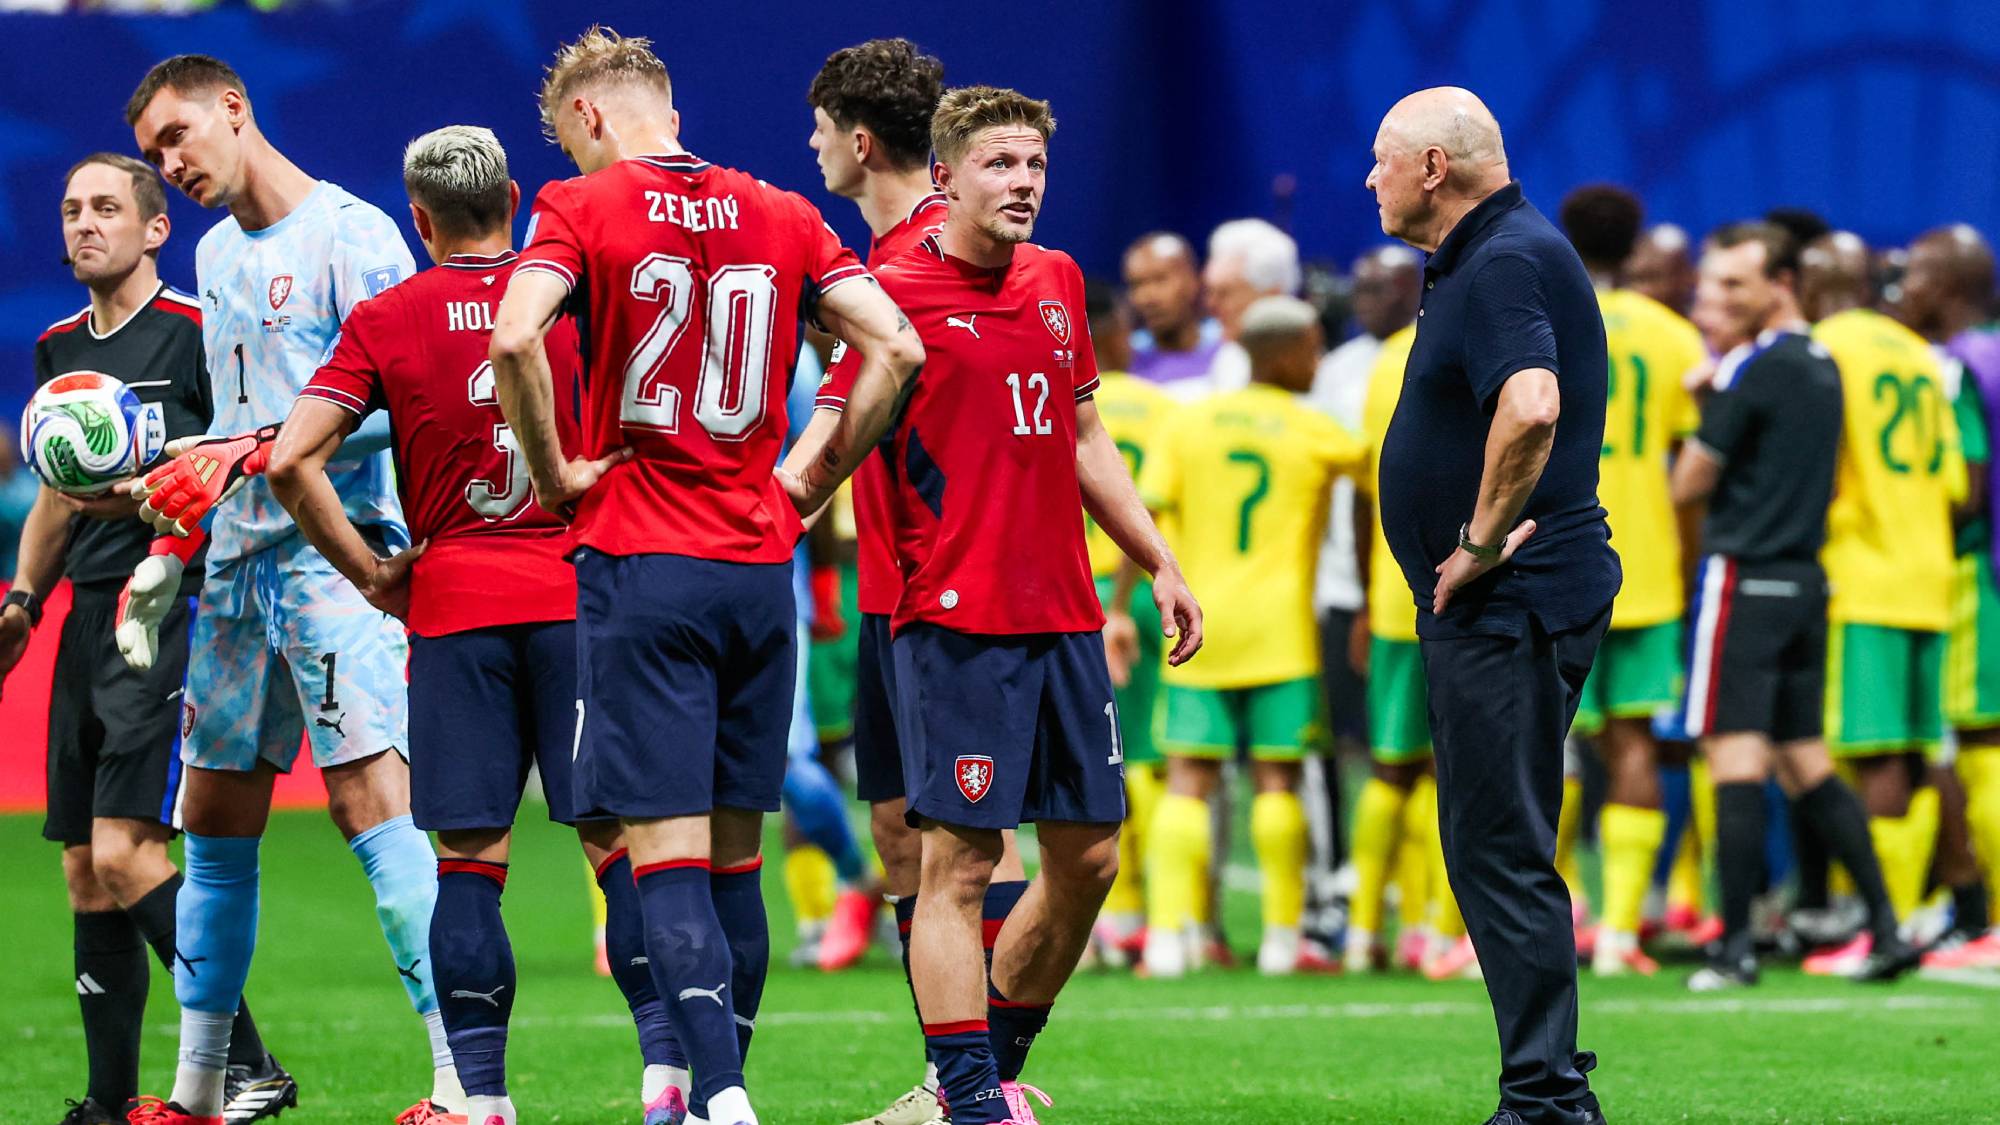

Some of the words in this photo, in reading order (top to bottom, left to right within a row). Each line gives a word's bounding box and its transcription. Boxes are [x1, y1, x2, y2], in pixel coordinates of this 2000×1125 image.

[645, 190, 739, 232] ZELENÝ
[447, 300, 503, 331] HOL
[234, 343, 249, 404] 1
[620, 252, 777, 442] 20
[1006, 373, 1052, 435] 12
[1875, 372, 1943, 473] 20
[464, 360, 534, 522] 3
[1229, 451, 1269, 552] 7
[320, 652, 339, 711] 1
[1104, 702, 1123, 765] 1
